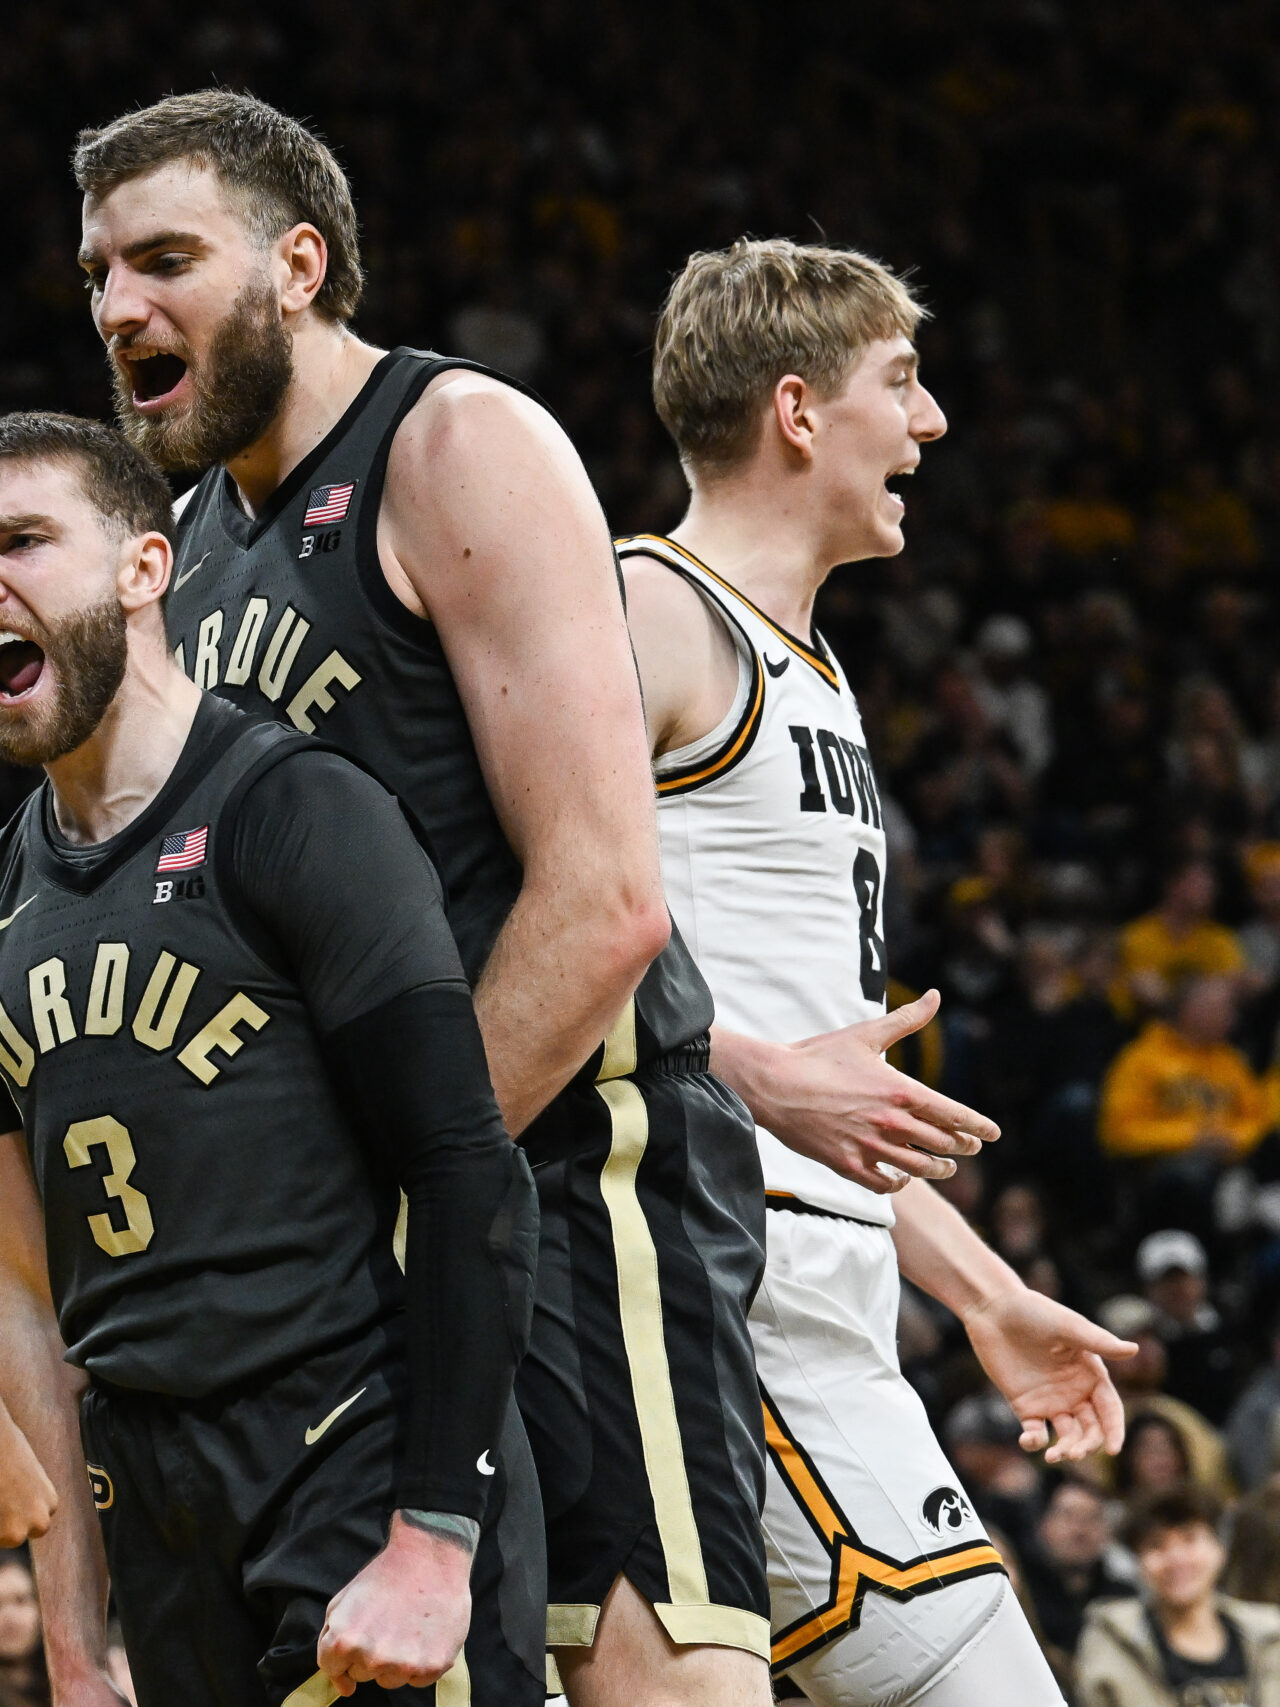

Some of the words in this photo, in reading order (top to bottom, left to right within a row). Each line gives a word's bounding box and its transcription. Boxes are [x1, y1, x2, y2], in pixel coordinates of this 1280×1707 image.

[174, 597, 365, 736] RDUE
[788, 725, 882, 830] IOW
[852, 846, 888, 1005] 8
[62, 1114, 155, 1258] 3
